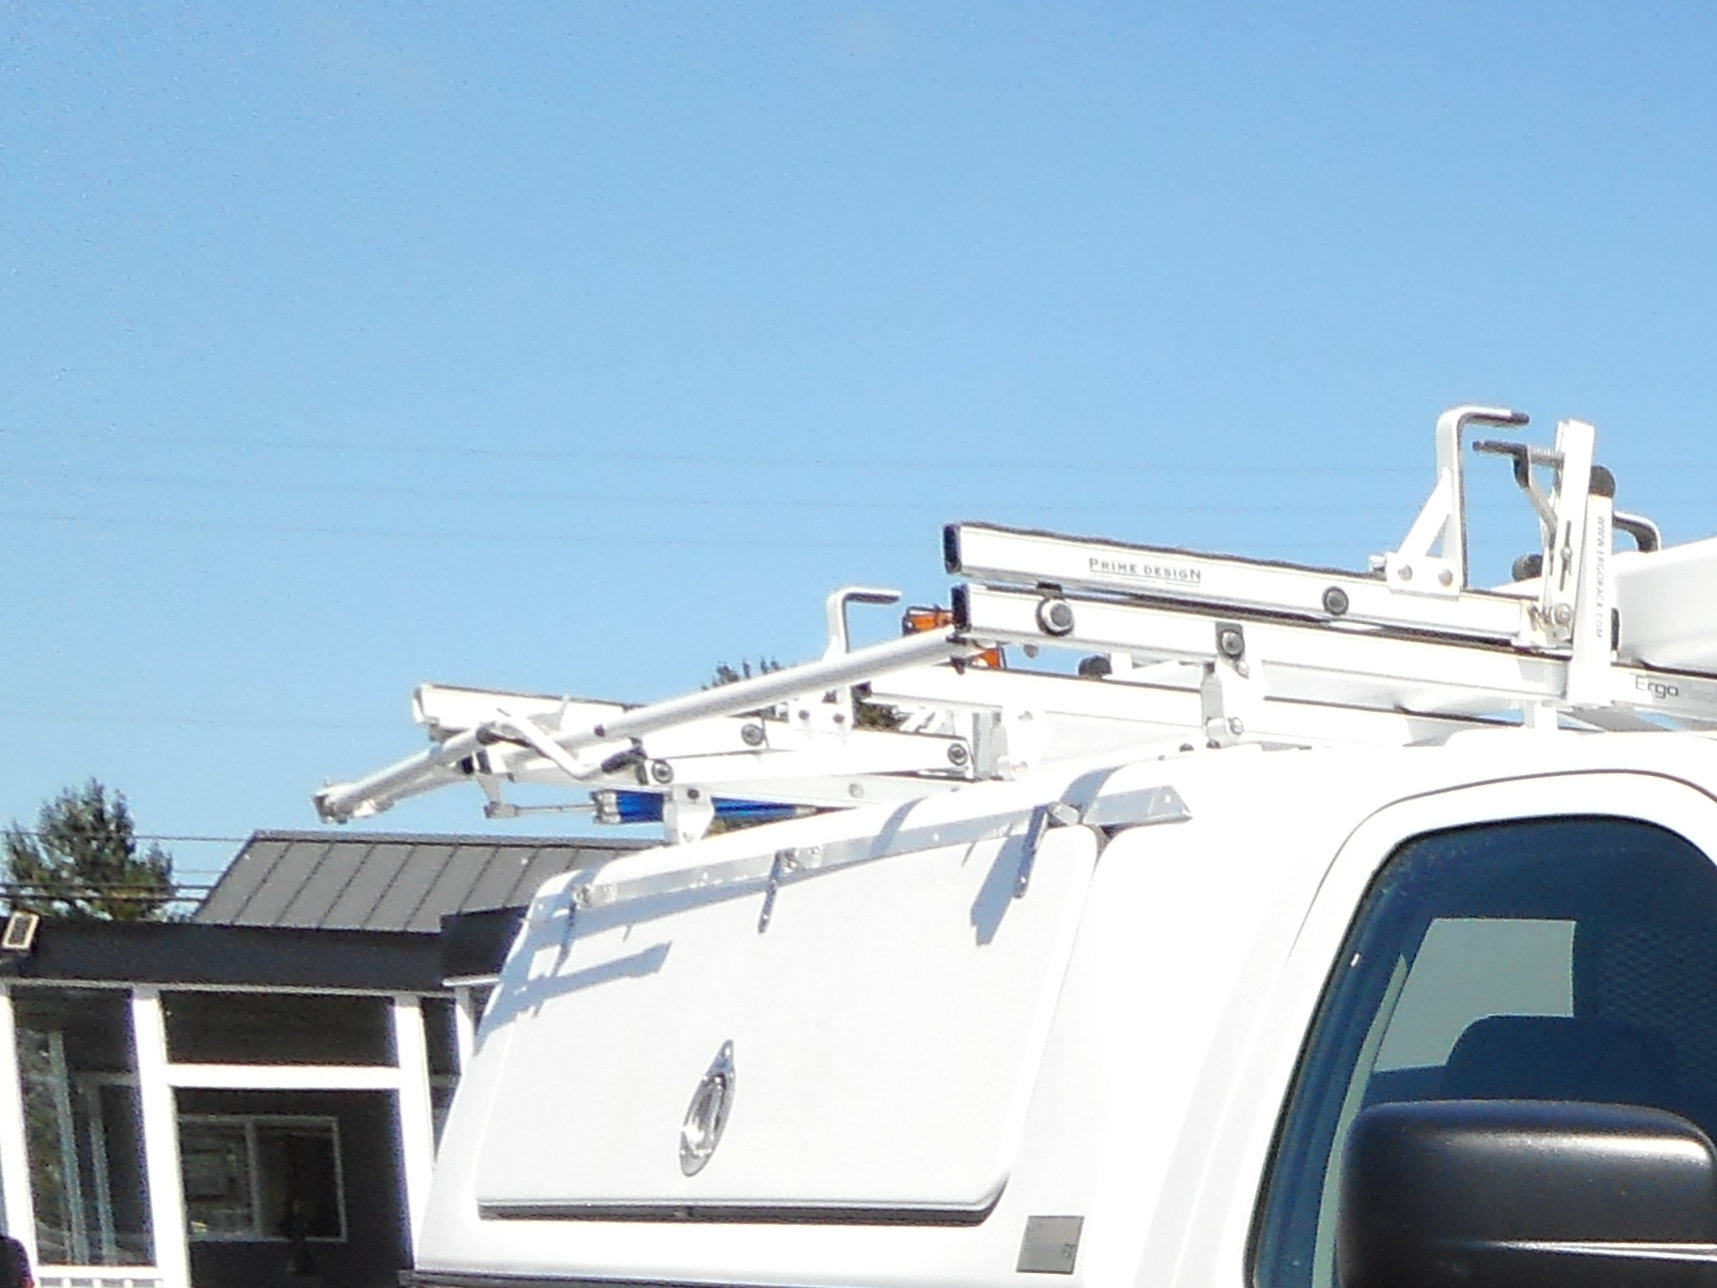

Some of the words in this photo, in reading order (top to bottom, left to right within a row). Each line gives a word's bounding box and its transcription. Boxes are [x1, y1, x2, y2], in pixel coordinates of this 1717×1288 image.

[1088, 557, 1138, 574] PRIME
[1143, 564, 1201, 580] DESIGN
[1635, 675, 1679, 699] Ergo
